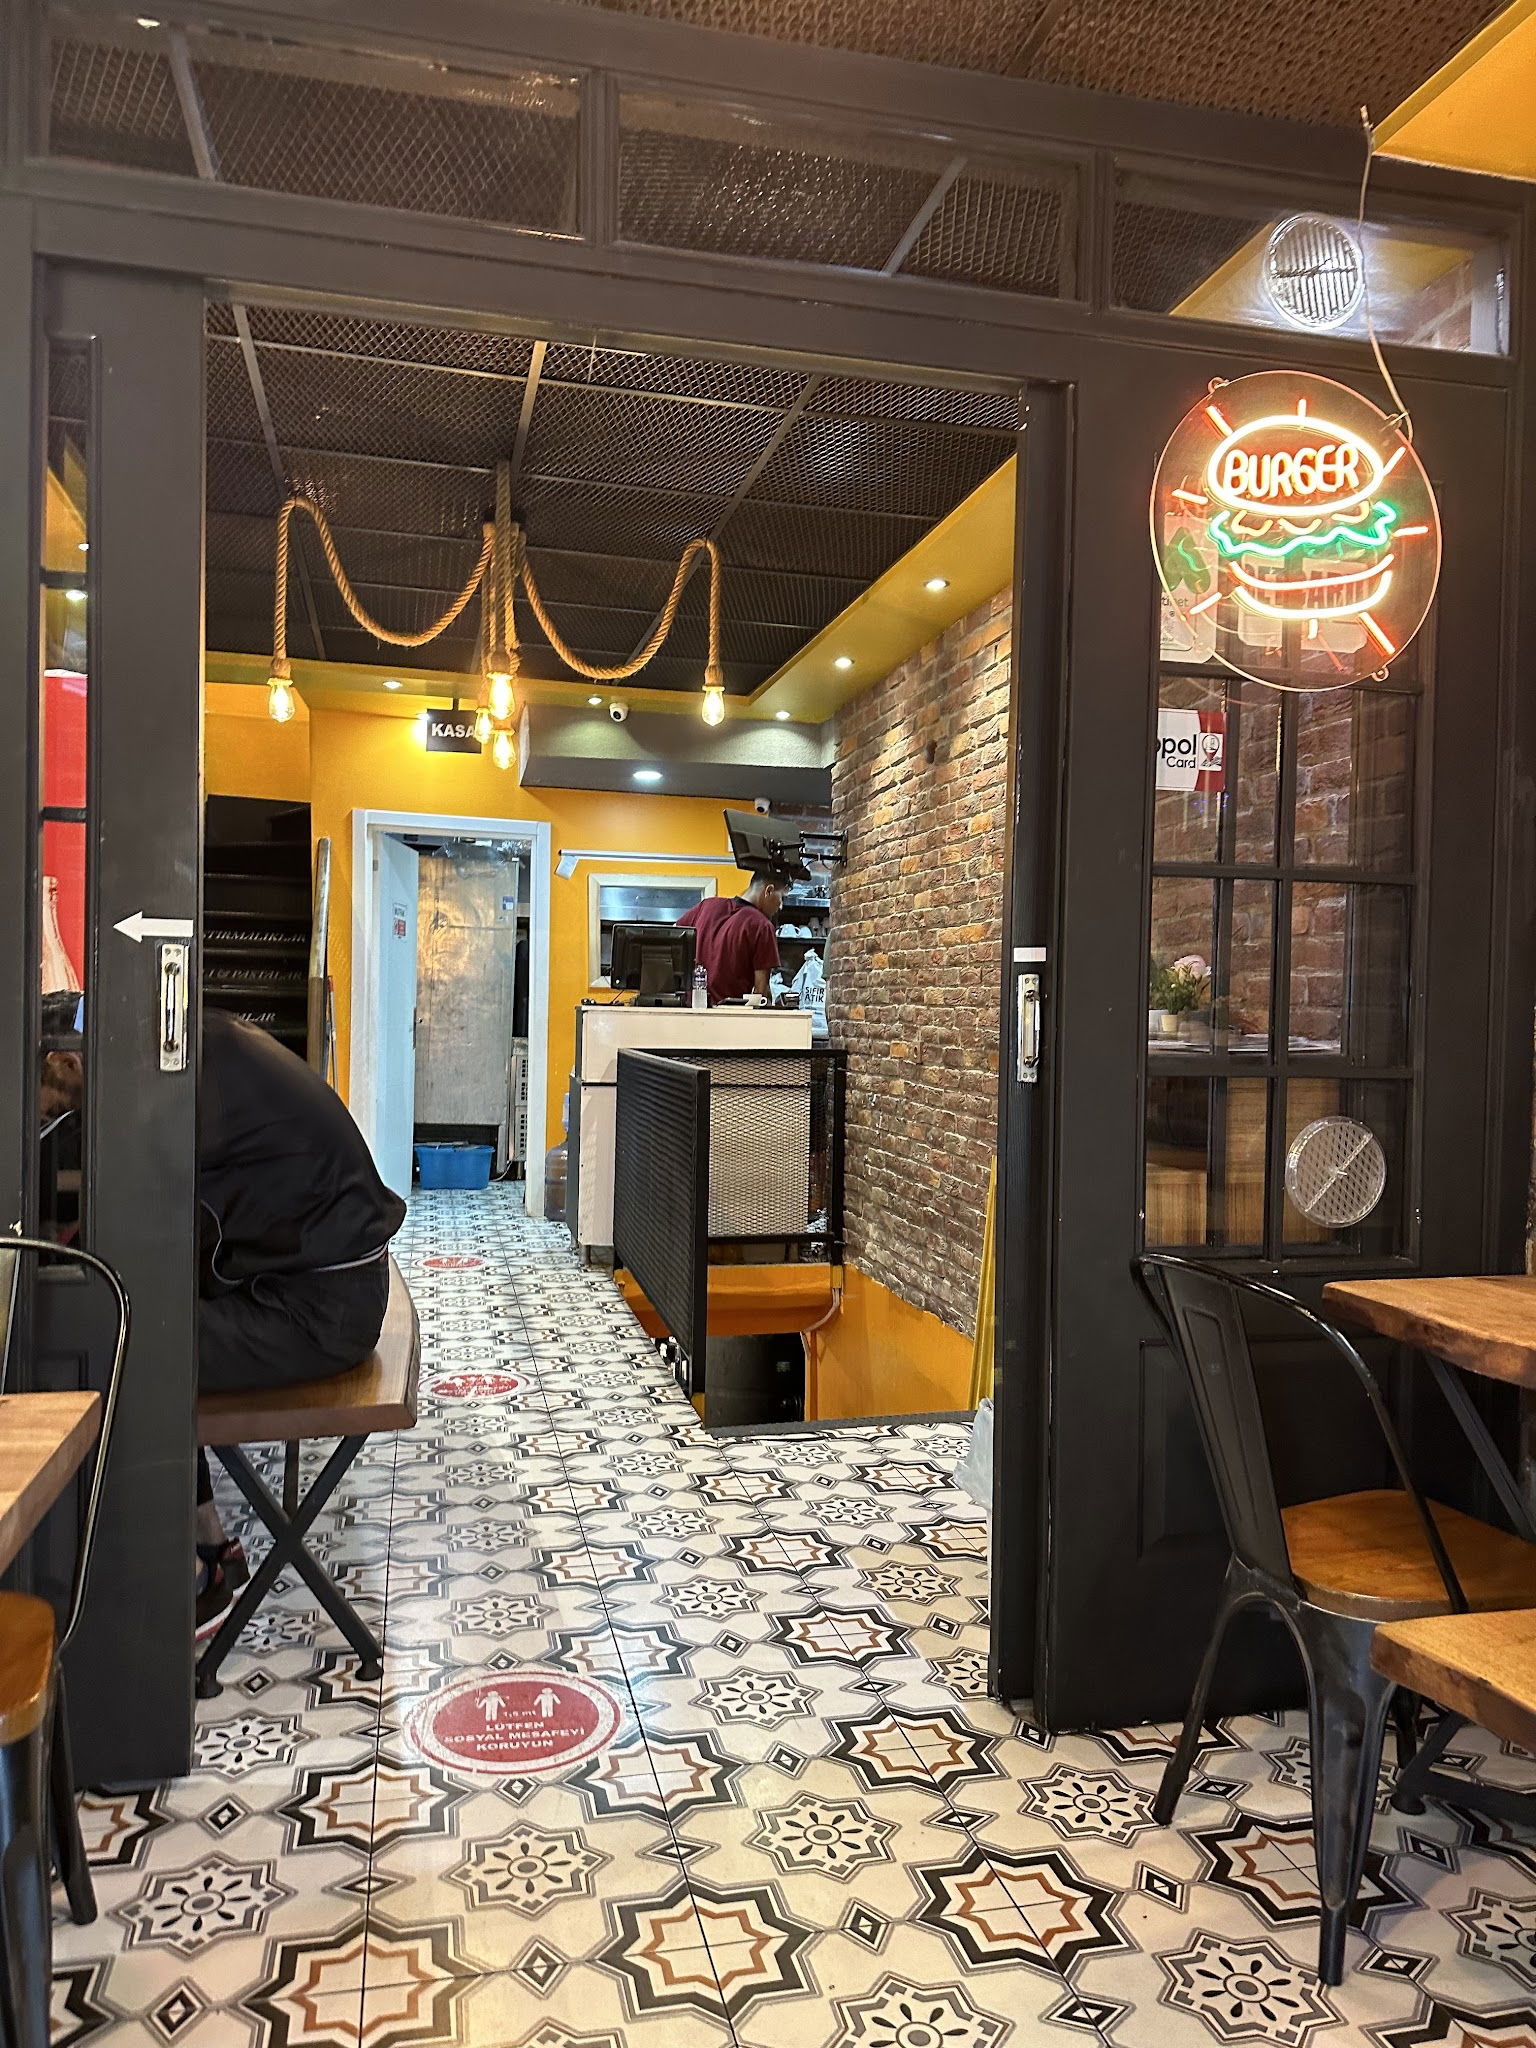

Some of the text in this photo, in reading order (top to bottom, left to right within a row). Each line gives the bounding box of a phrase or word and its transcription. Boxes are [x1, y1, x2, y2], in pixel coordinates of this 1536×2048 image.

[1224, 444, 1359, 498] BURGER
[1166, 756, 1196, 768] Card
[444, 1733, 504, 1743] SOSYAL
[476, 1739, 554, 1751] KORUYUN
